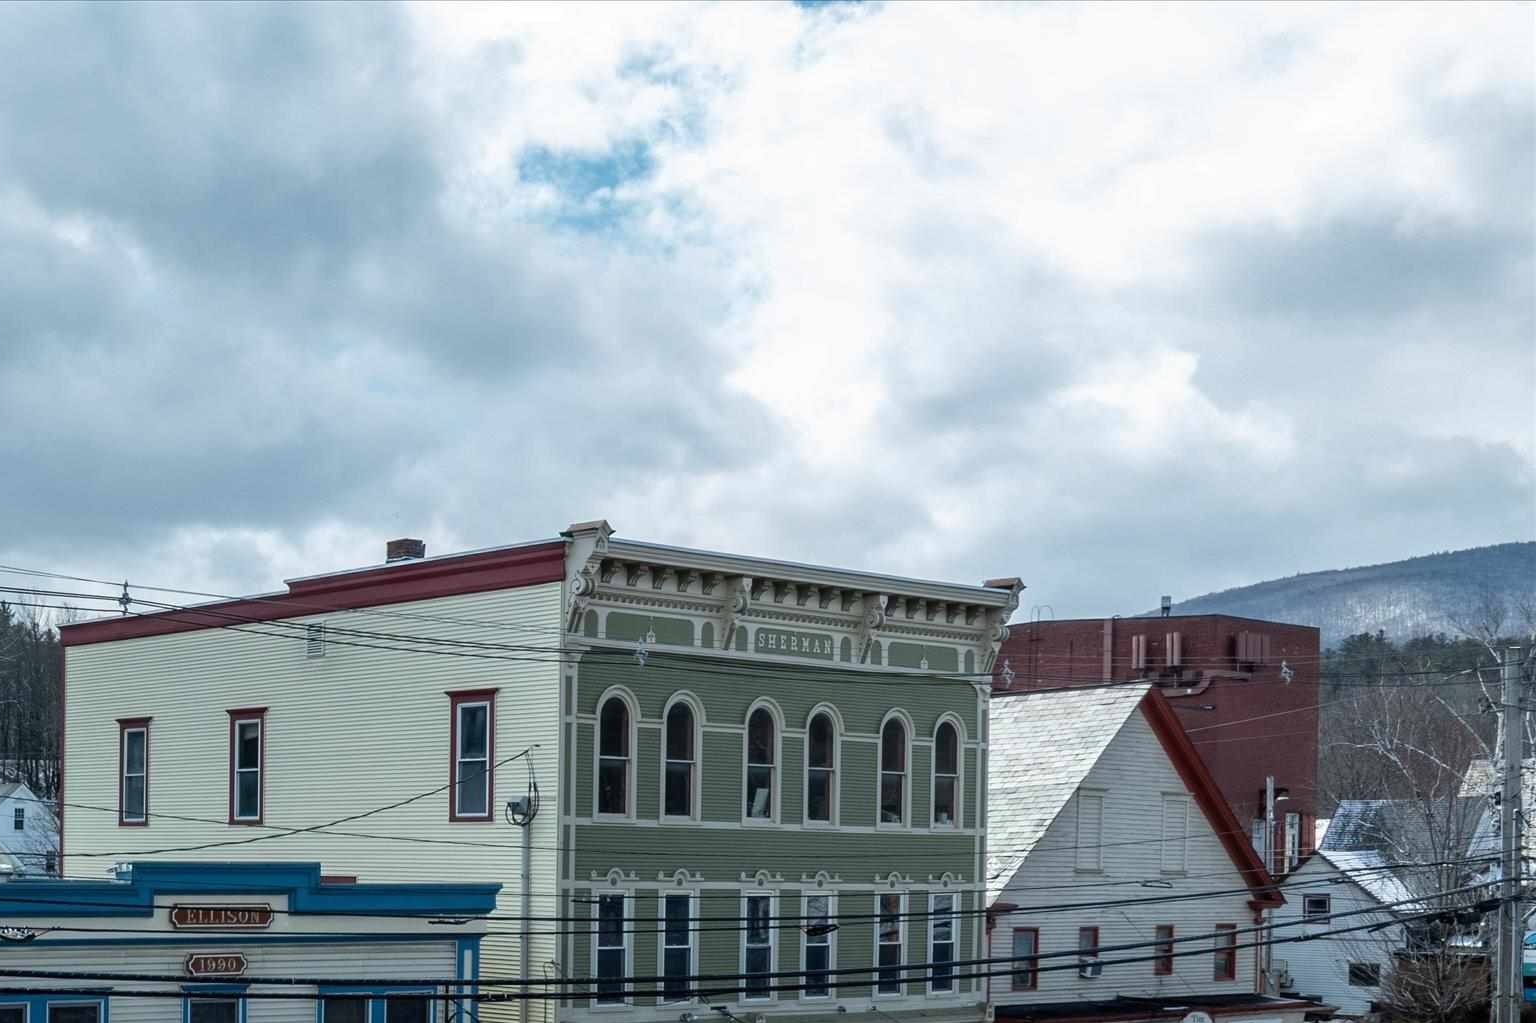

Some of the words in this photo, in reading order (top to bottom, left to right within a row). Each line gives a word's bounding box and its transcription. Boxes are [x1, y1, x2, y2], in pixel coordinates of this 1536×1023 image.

[758, 632, 832, 655] SHERMAN
[186, 908, 260, 924] ELLISON
[199, 958, 237, 972] 1990
